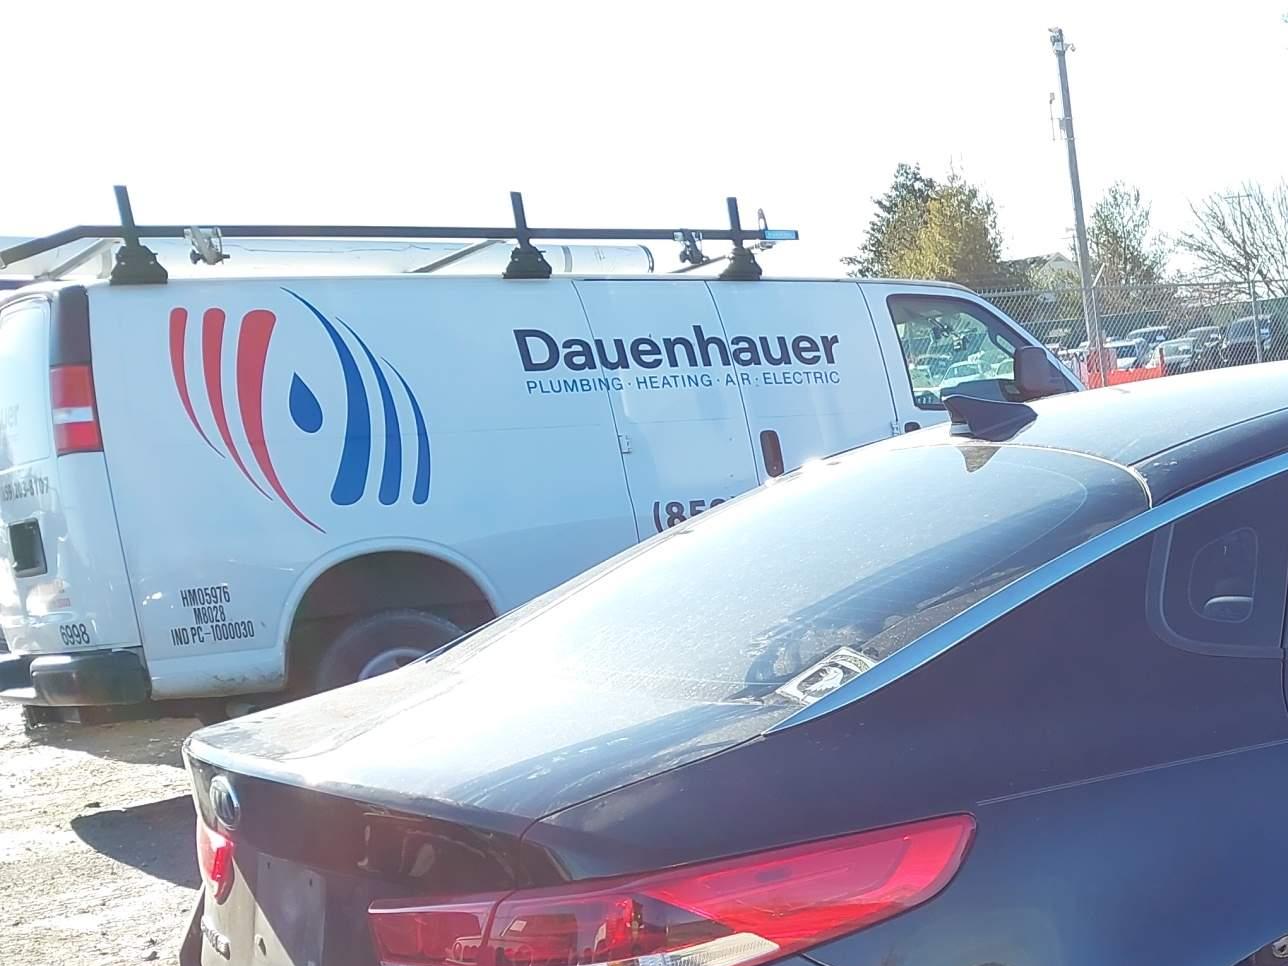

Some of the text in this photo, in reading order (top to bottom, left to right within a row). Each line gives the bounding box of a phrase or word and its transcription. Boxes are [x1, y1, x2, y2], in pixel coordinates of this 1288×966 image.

[512, 324, 840, 372] Dauenhauer
[526, 376, 624, 394] PLUMBING
[636, 374, 713, 390] HEATING
[762, 371, 840, 385] ELECTRIC
[193, 605, 226, 625] M8028
[60, 623, 90, 646] 6998
[171, 620, 255, 646] IND PC-1000030
